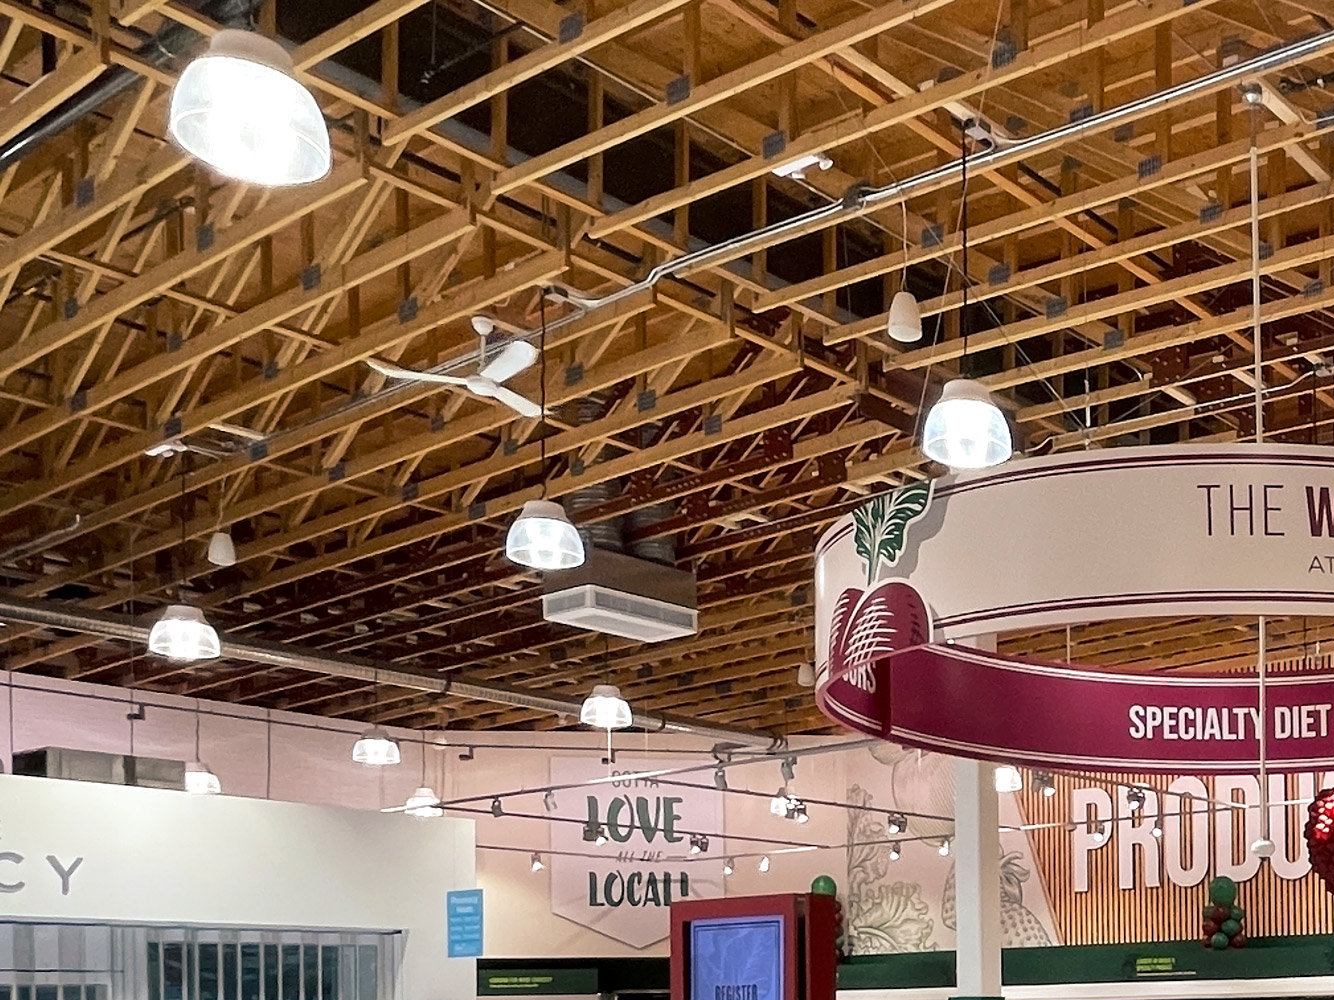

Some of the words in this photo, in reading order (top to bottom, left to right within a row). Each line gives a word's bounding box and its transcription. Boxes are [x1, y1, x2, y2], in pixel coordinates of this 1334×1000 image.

[1197, 484, 1285, 536] THE
[1308, 556, 1334, 574] AT
[1128, 705, 1265, 740] SPECIALTY
[1274, 704, 1331, 739] DIET
[586, 794, 683, 844] LOVE
